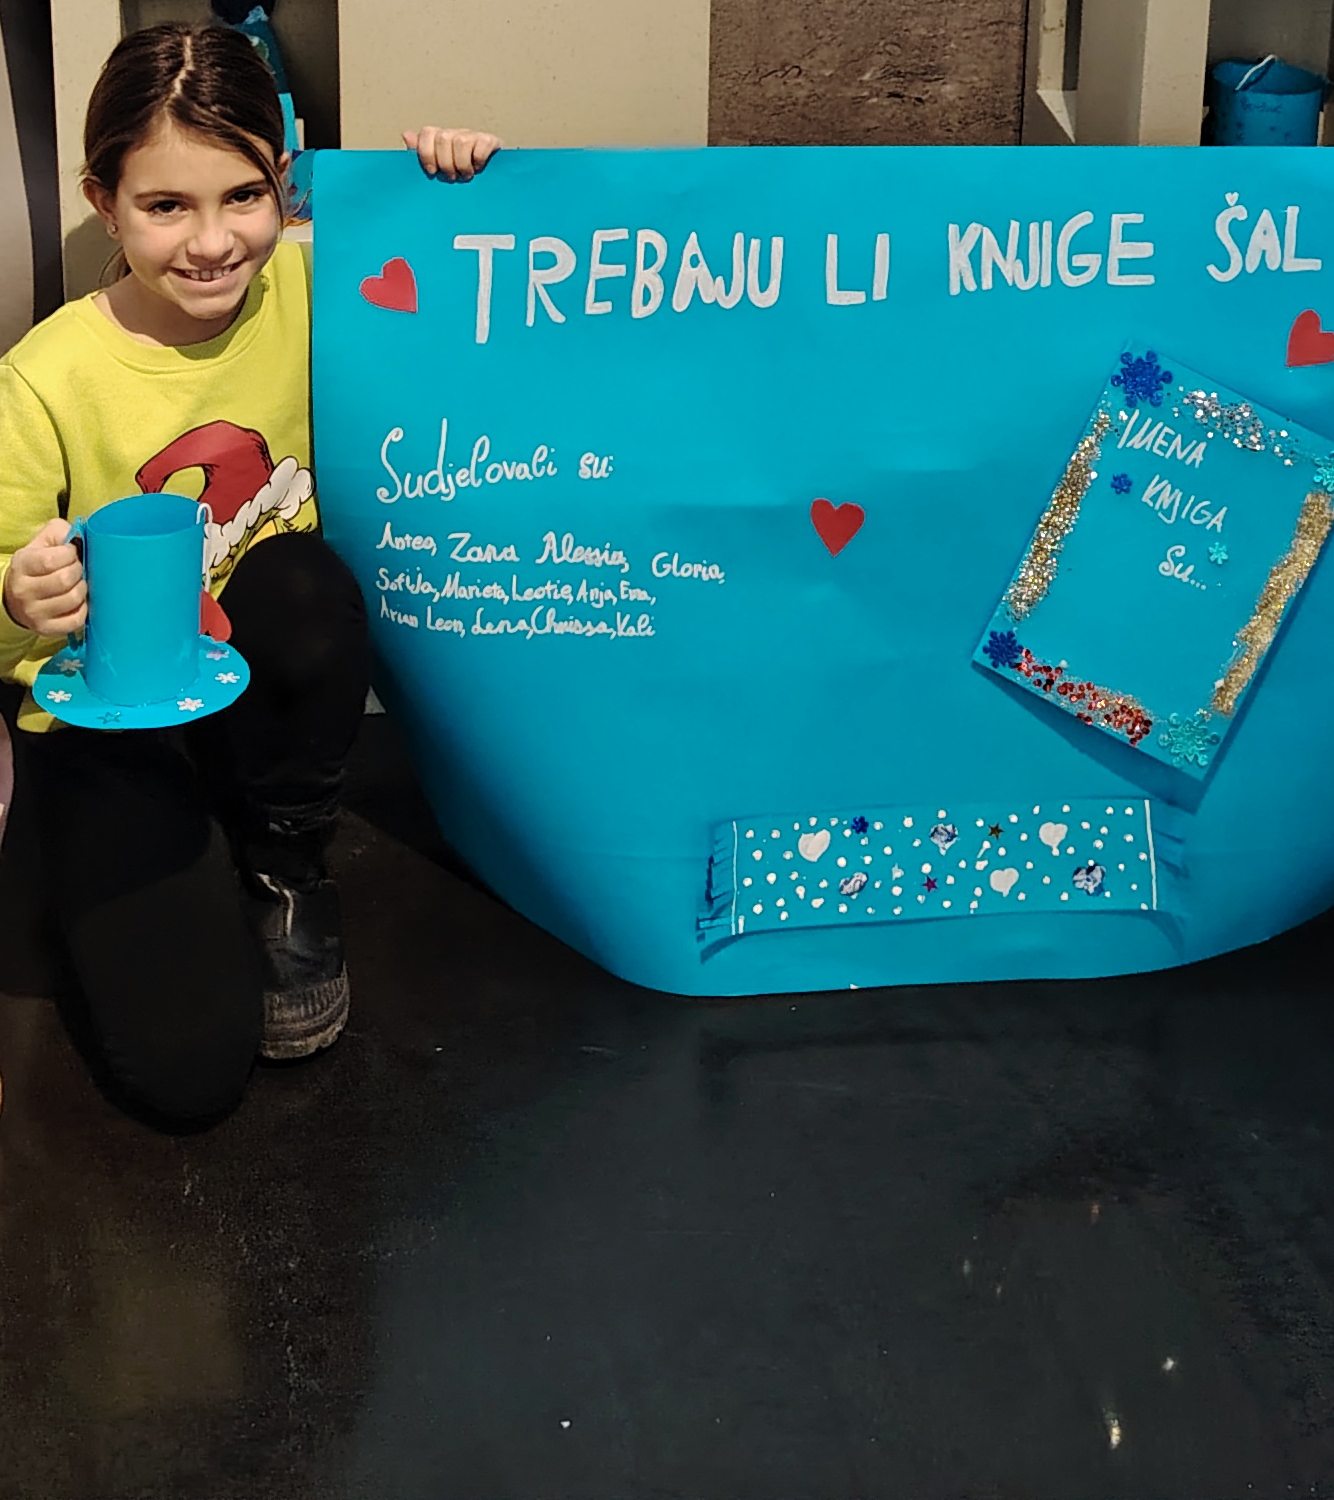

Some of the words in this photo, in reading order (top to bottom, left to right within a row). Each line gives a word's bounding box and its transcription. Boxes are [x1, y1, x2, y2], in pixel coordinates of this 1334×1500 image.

[453, 228, 784, 344] TREBAJU
[826, 232, 890, 306] LI
[948, 210, 1155, 295] KNJIGE
[1206, 191, 1323, 282] ŠAL
[376, 417, 558, 503] Sudjelovali
[1118, 408, 1207, 468] IMENA
[1141, 474, 1228, 533] KNJIGA
